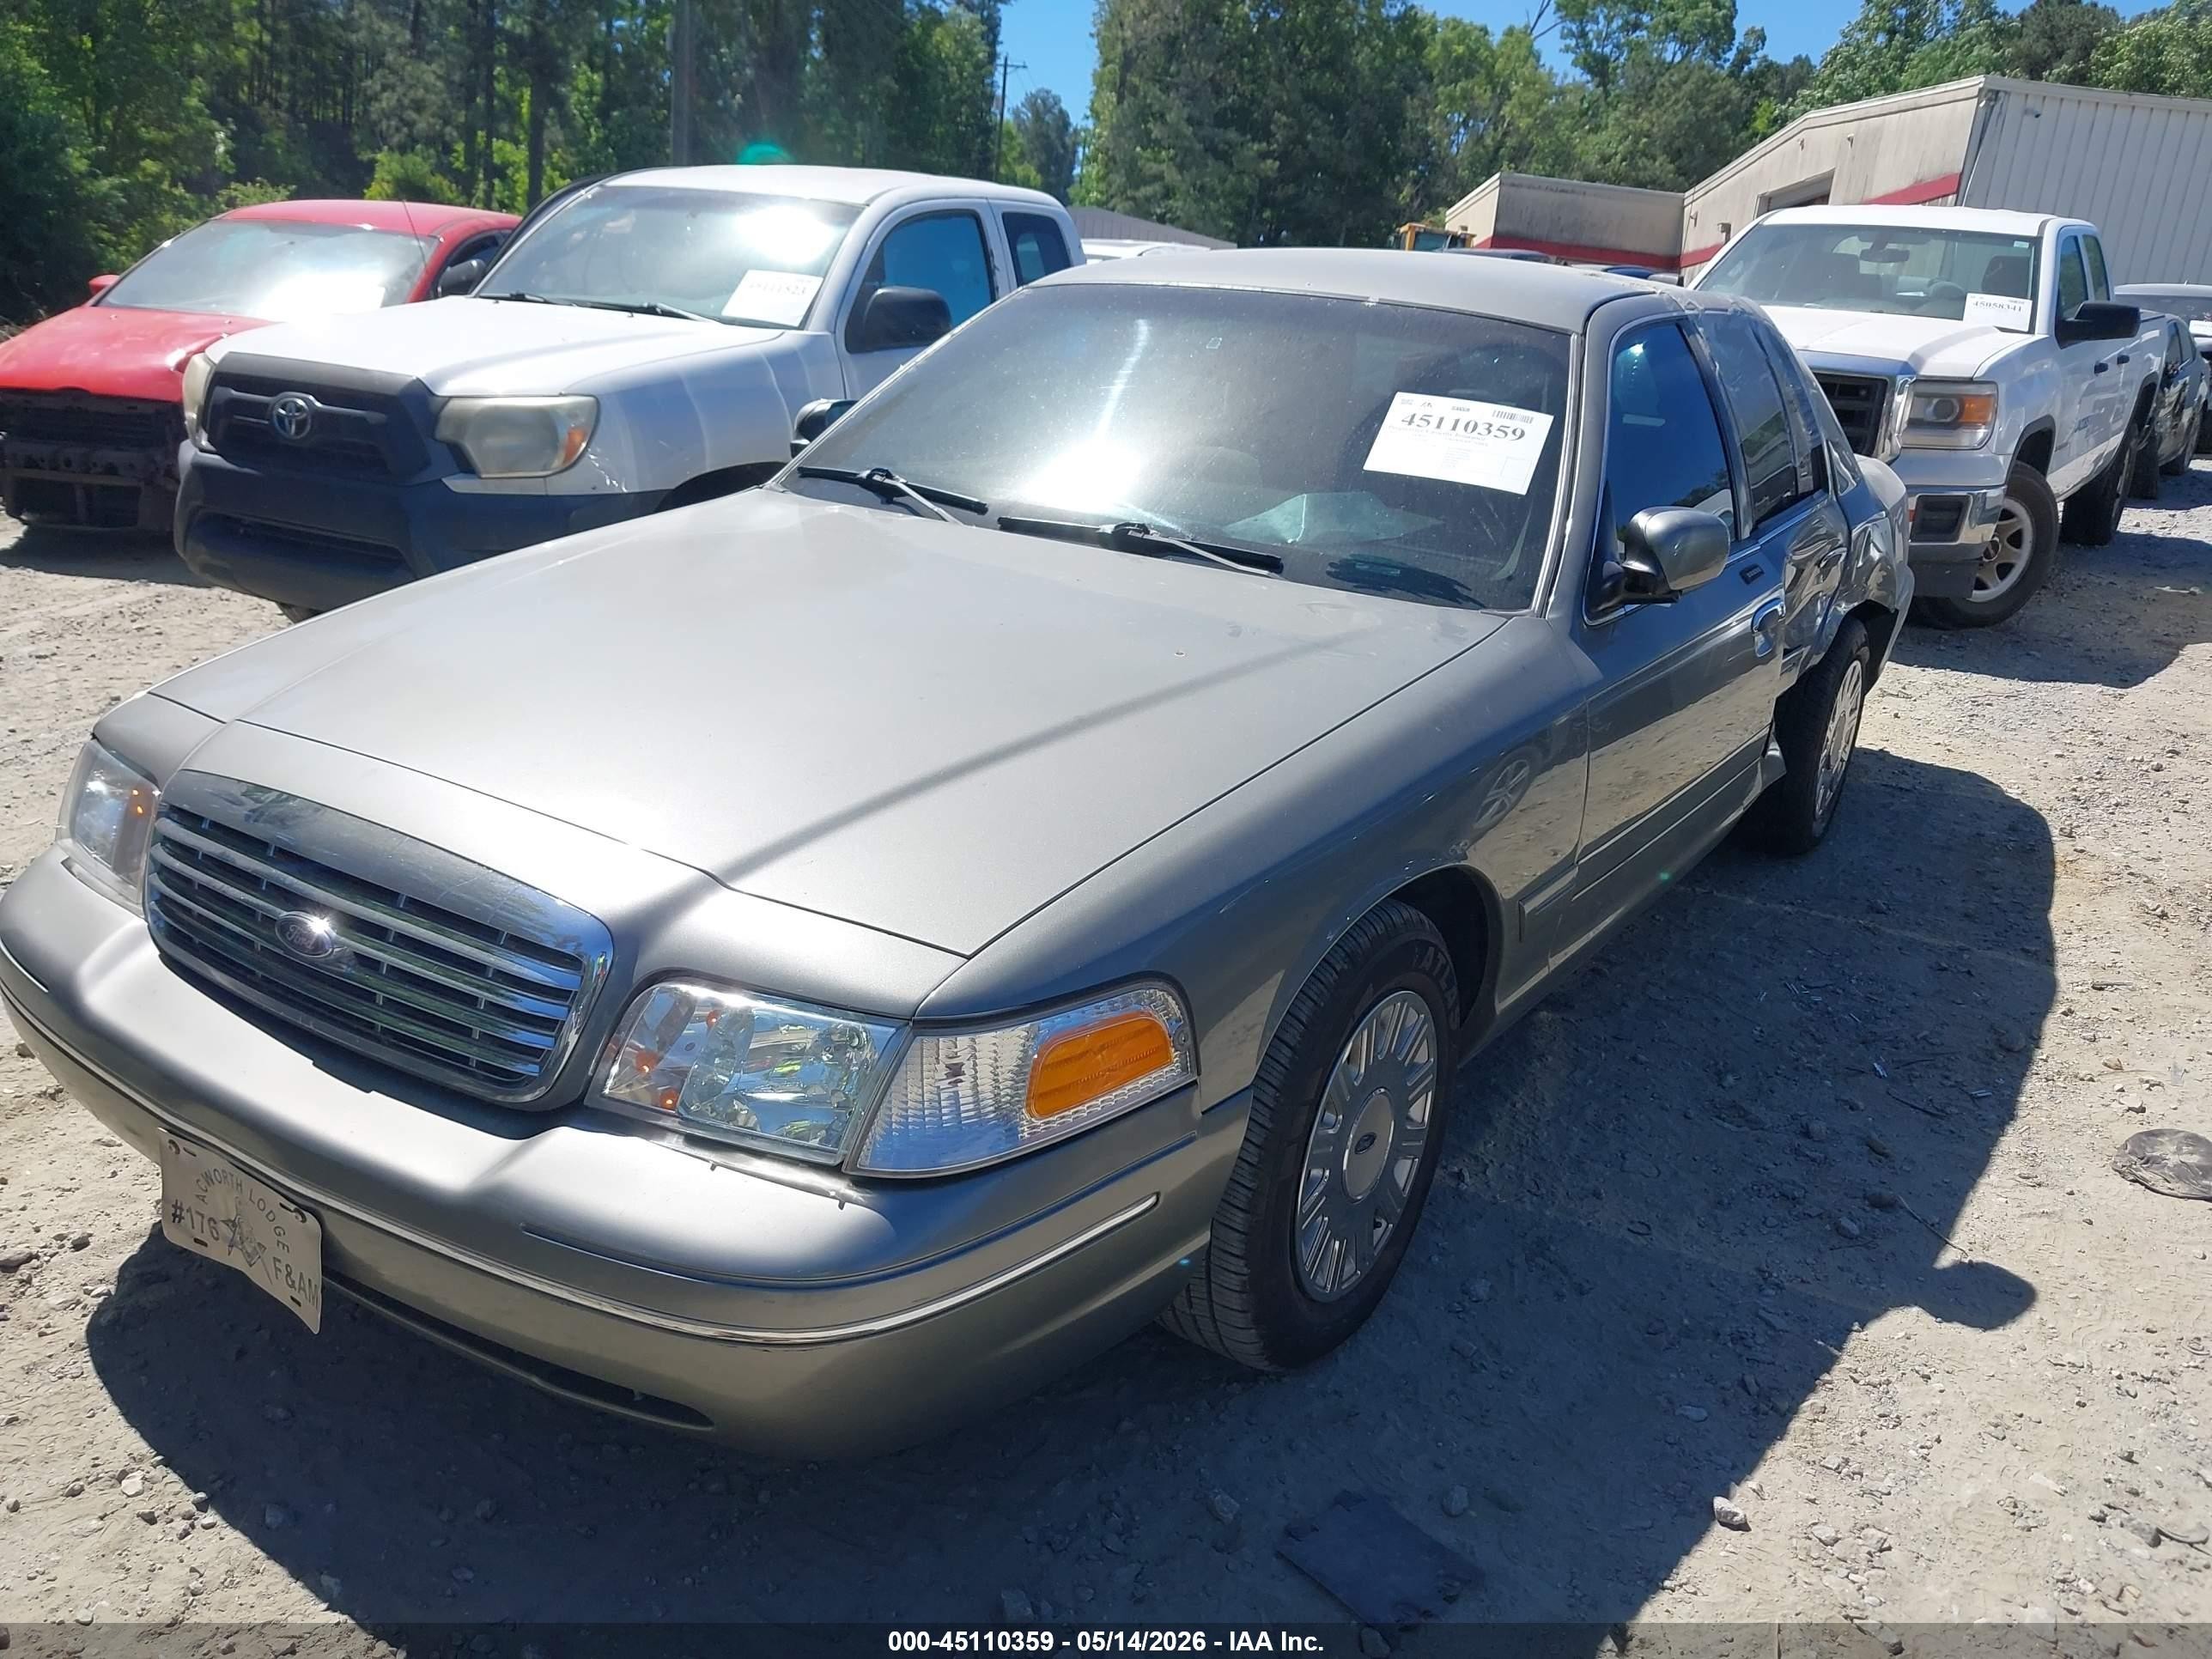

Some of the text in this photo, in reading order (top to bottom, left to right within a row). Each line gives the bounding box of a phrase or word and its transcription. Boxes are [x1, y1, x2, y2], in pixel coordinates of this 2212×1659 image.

[1401, 412, 1526, 441] 45110359
[286, 924, 319, 949] Ford
[1419, 945, 1459, 1030] ATLAS
[172, 1199, 220, 1242] #176
[195, 1168, 290, 1254] ACWORTH LODGE
[273, 1256, 319, 1310] F&AM
